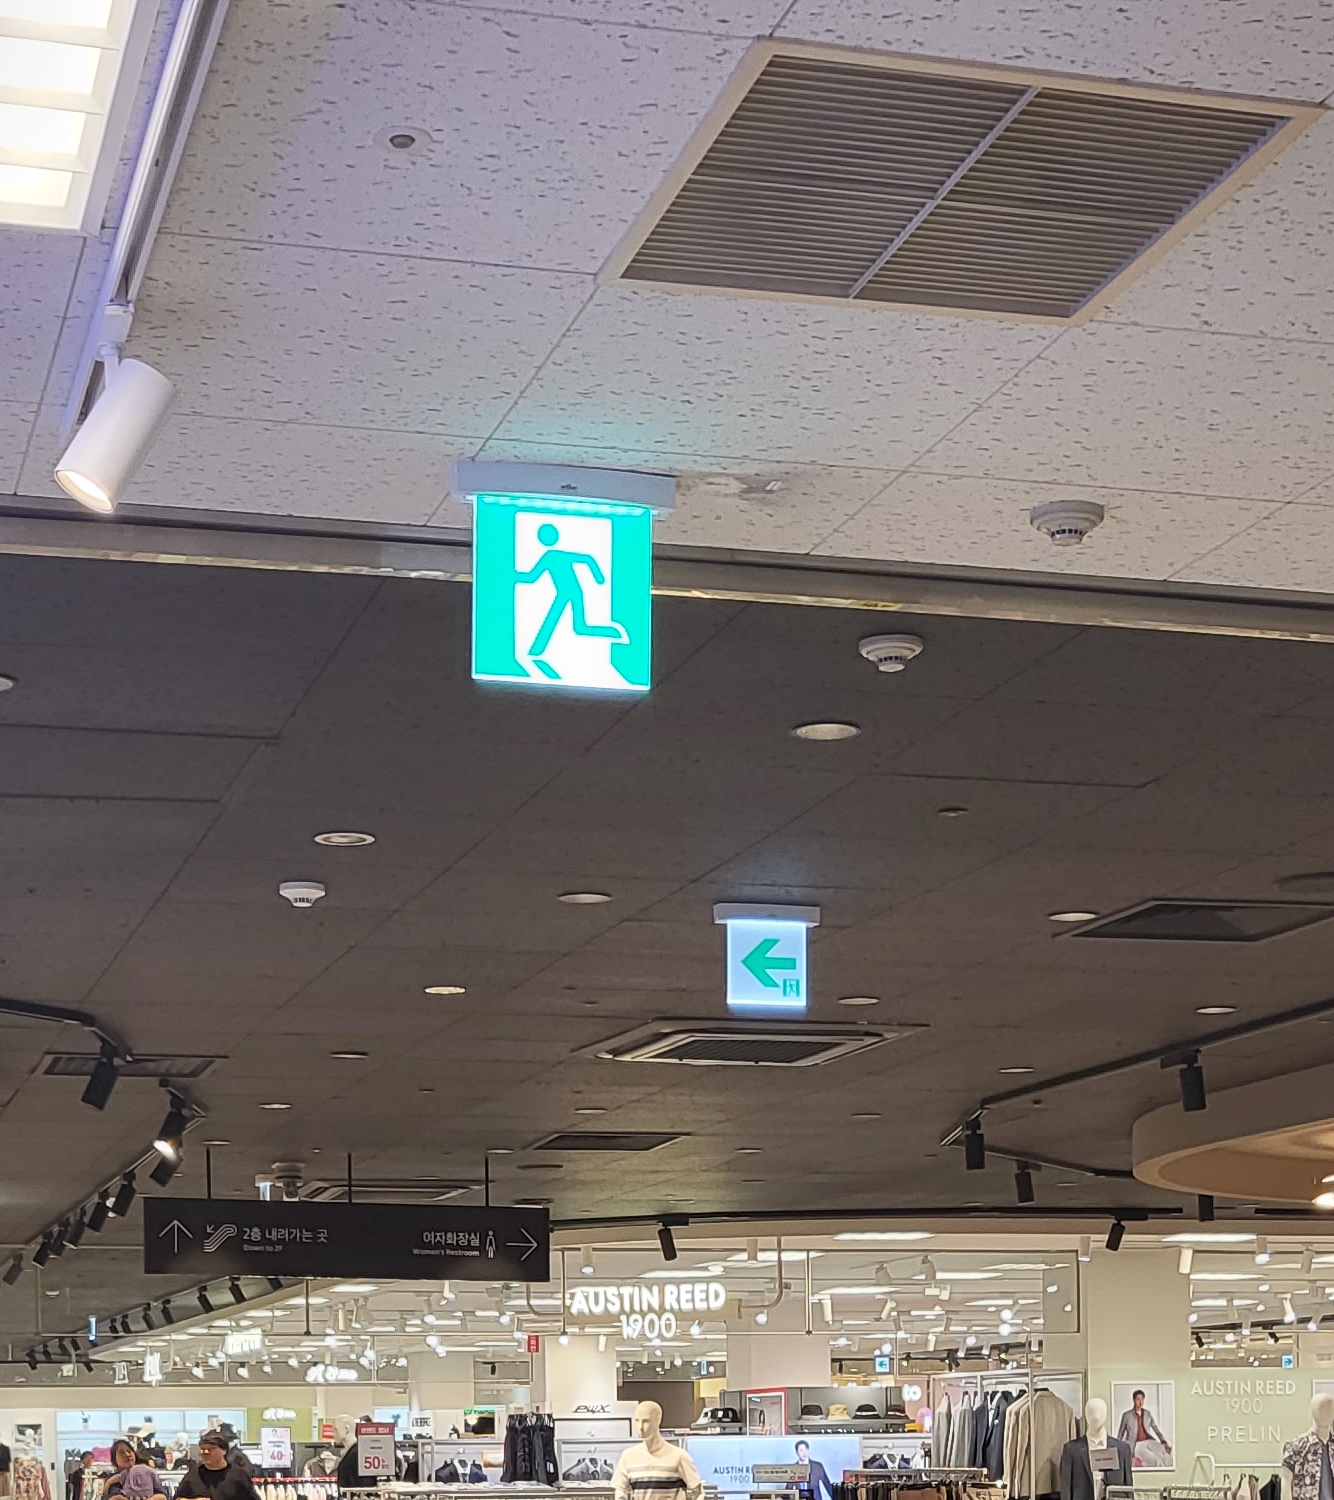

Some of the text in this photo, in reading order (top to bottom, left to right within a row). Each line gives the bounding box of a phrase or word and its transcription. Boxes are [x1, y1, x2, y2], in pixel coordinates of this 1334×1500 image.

[242, 1227, 329, 1243] 2층 내려가는 곳
[422, 1231, 480, 1247] 여자화장실
[243, 1244, 264, 1252] Down
[412, 1248, 480, 1257] Women's Restroom
[570, 1281, 727, 1316] AUSTIN REED
[620, 1312, 677, 1340] 1900
[1191, 1380, 1297, 1396] AUSTIN REED
[1224, 1398, 1263, 1415] 1900
[1207, 1425, 1281, 1443] PRELIN
[364, 1456, 381, 1470] 50
[713, 1466, 745, 1475] AUSTIN
[730, 1475, 750, 1484] 1900
